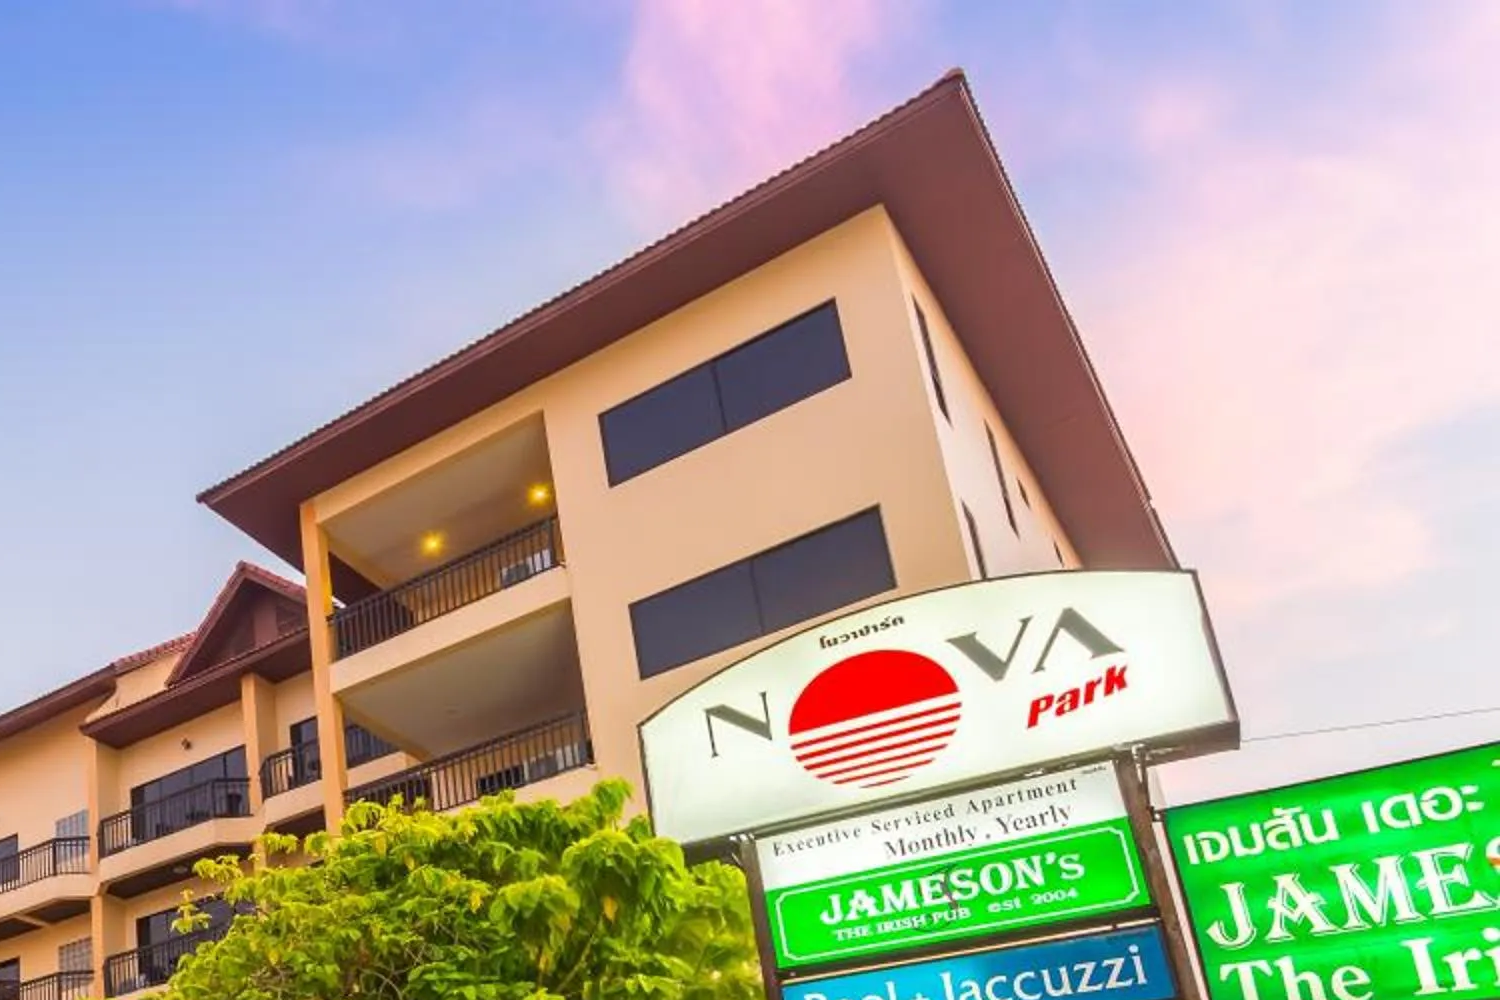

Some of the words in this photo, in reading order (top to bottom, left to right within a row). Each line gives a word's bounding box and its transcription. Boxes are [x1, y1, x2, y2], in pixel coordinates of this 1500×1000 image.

[1026, 662, 1129, 729] Park
[772, 826, 862, 858] Executive
[871, 804, 955, 835] Serviced
[966, 778, 1079, 815] Apartment
[884, 824, 979, 860] Monthly
[995, 802, 1072, 838] Yearly
[1182, 806, 1340, 865] เจมสัน
[1360, 785, 1485, 834] เดอะ
[835, 923, 871, 942] THE
[877, 914, 928, 935] IRISH
[930, 906, 972, 926] PUB
[988, 896, 1023, 914] est
[1031, 887, 1079, 906] 2004
